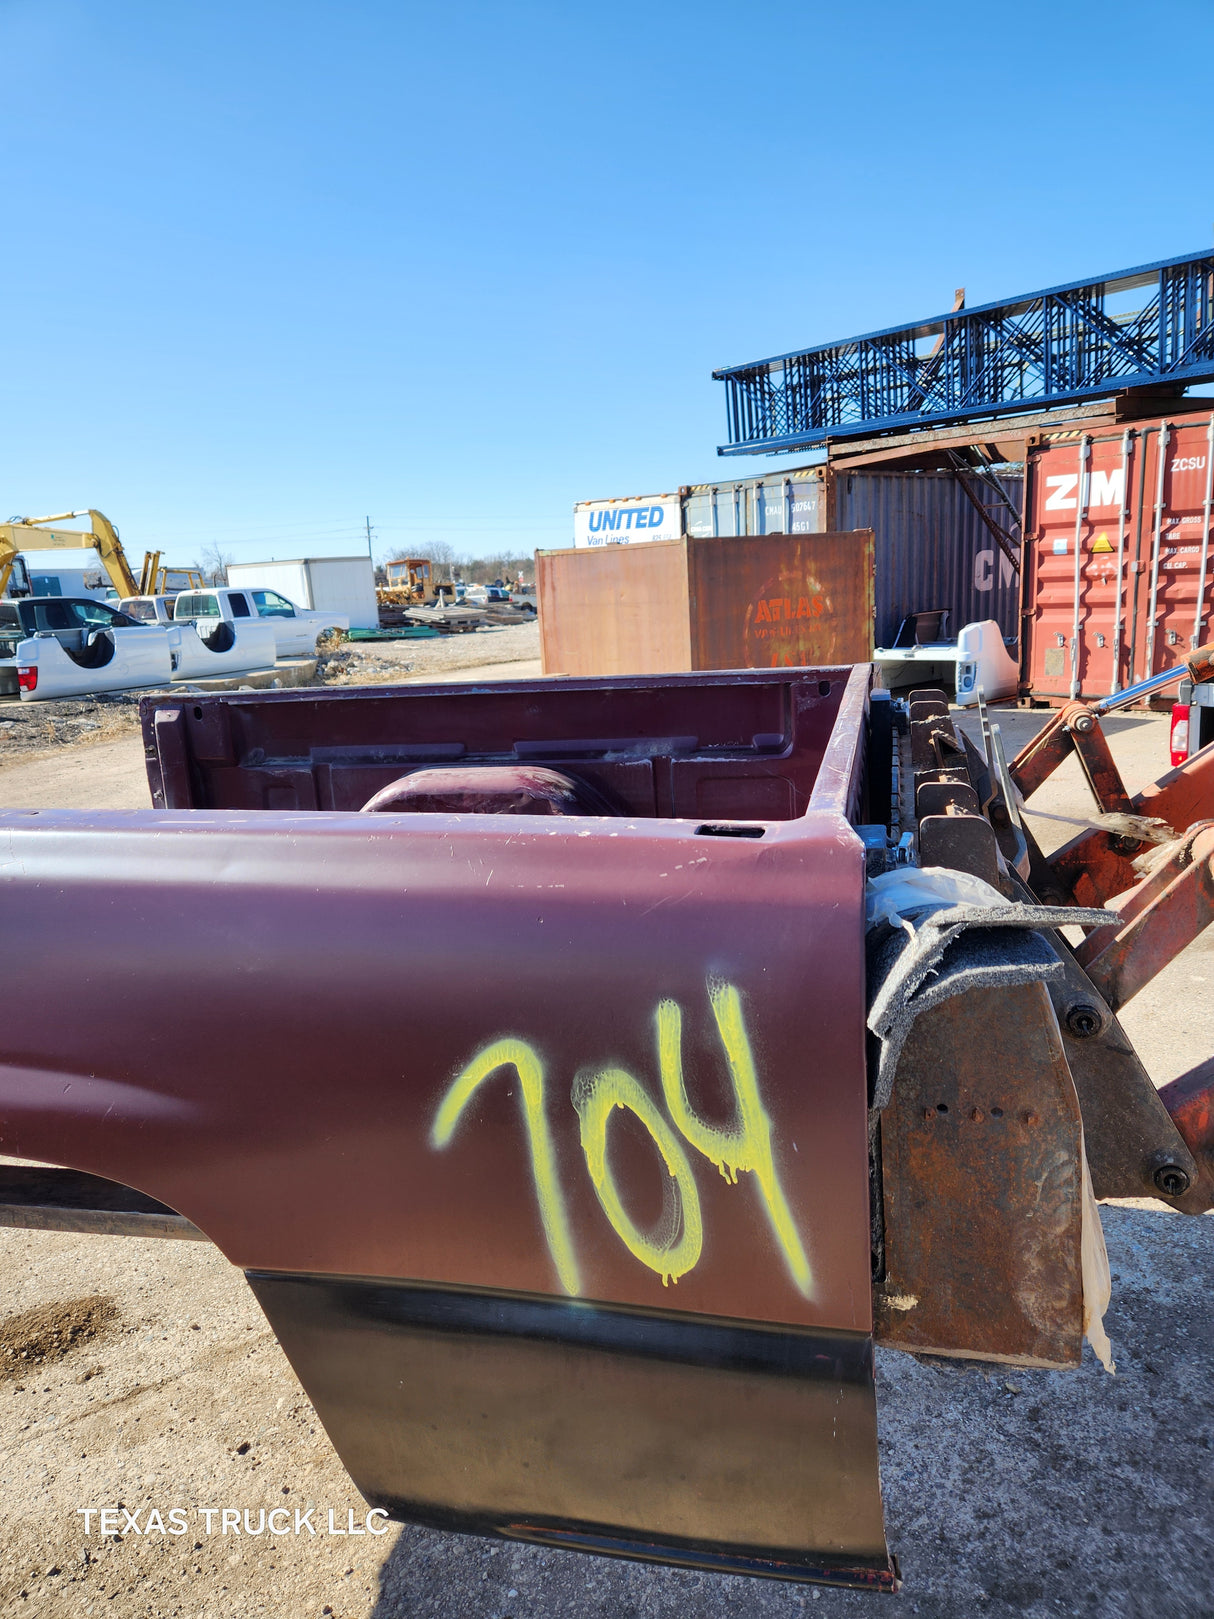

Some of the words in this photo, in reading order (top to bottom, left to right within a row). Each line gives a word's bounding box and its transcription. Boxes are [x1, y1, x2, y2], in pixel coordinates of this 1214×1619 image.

[1171, 456, 1206, 472] ZCSU
[1045, 468, 1124, 511] ZIM
[765, 505, 783, 516] CMAU
[589, 506, 664, 532] UNITED
[1181, 516, 1202, 524] GROSS
[792, 521, 810, 532] 45G1
[587, 535, 604, 546] Van
[606, 534, 630, 545] Lines
[1166, 532, 1181, 540] TARE
[1180, 546, 1200, 554] CARGO
[754, 595, 824, 624] ATLAS
[429, 973, 816, 1301] 704
